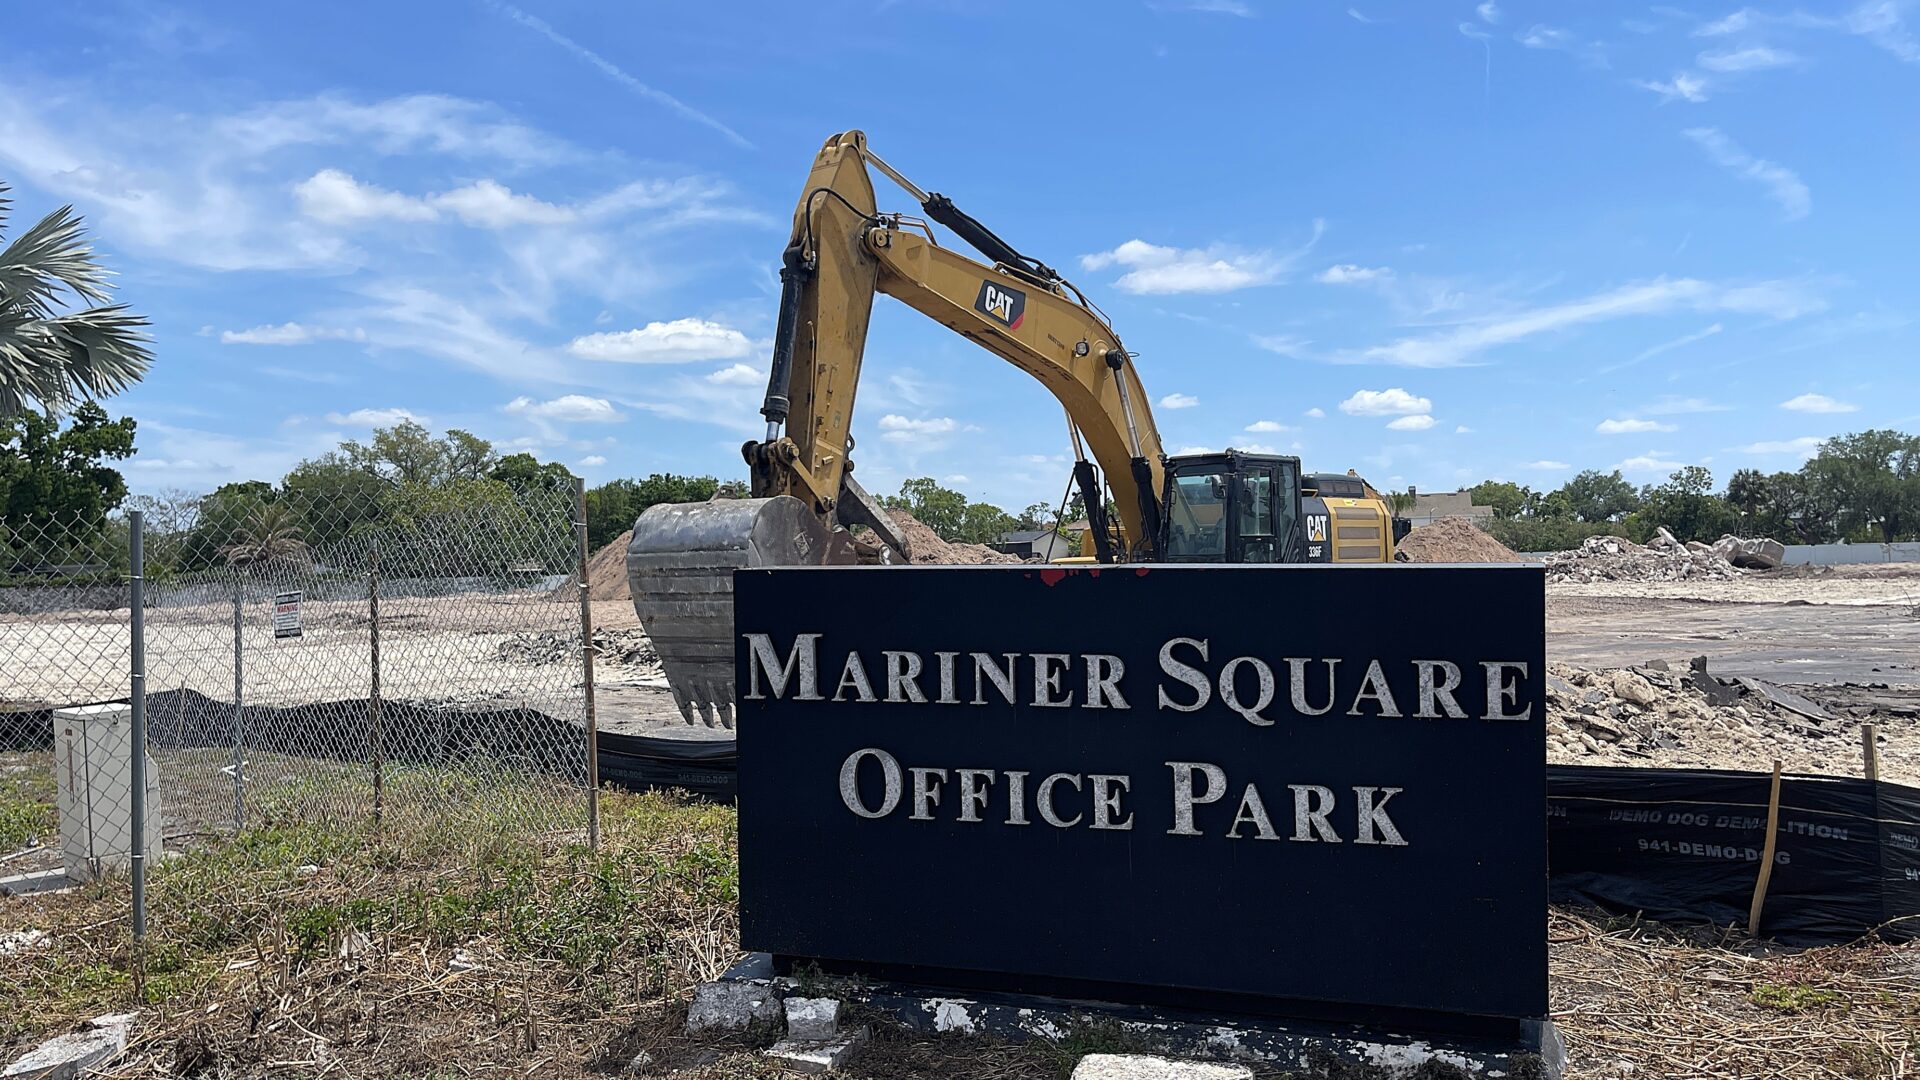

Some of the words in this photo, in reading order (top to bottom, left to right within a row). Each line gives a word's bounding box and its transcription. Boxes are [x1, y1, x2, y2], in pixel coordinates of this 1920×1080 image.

[984, 285, 1014, 322] CAT
[1306, 515, 1327, 541] CAT
[1308, 546, 1322, 558] 336F
[742, 633, 1131, 709] MARINER
[1158, 637, 1532, 727] SQUARE
[839, 748, 1134, 831] OFFICE
[1164, 761, 1409, 846] PARK
[1609, 809, 1662, 823] DEMO
[1667, 812, 1709, 827] DOG
